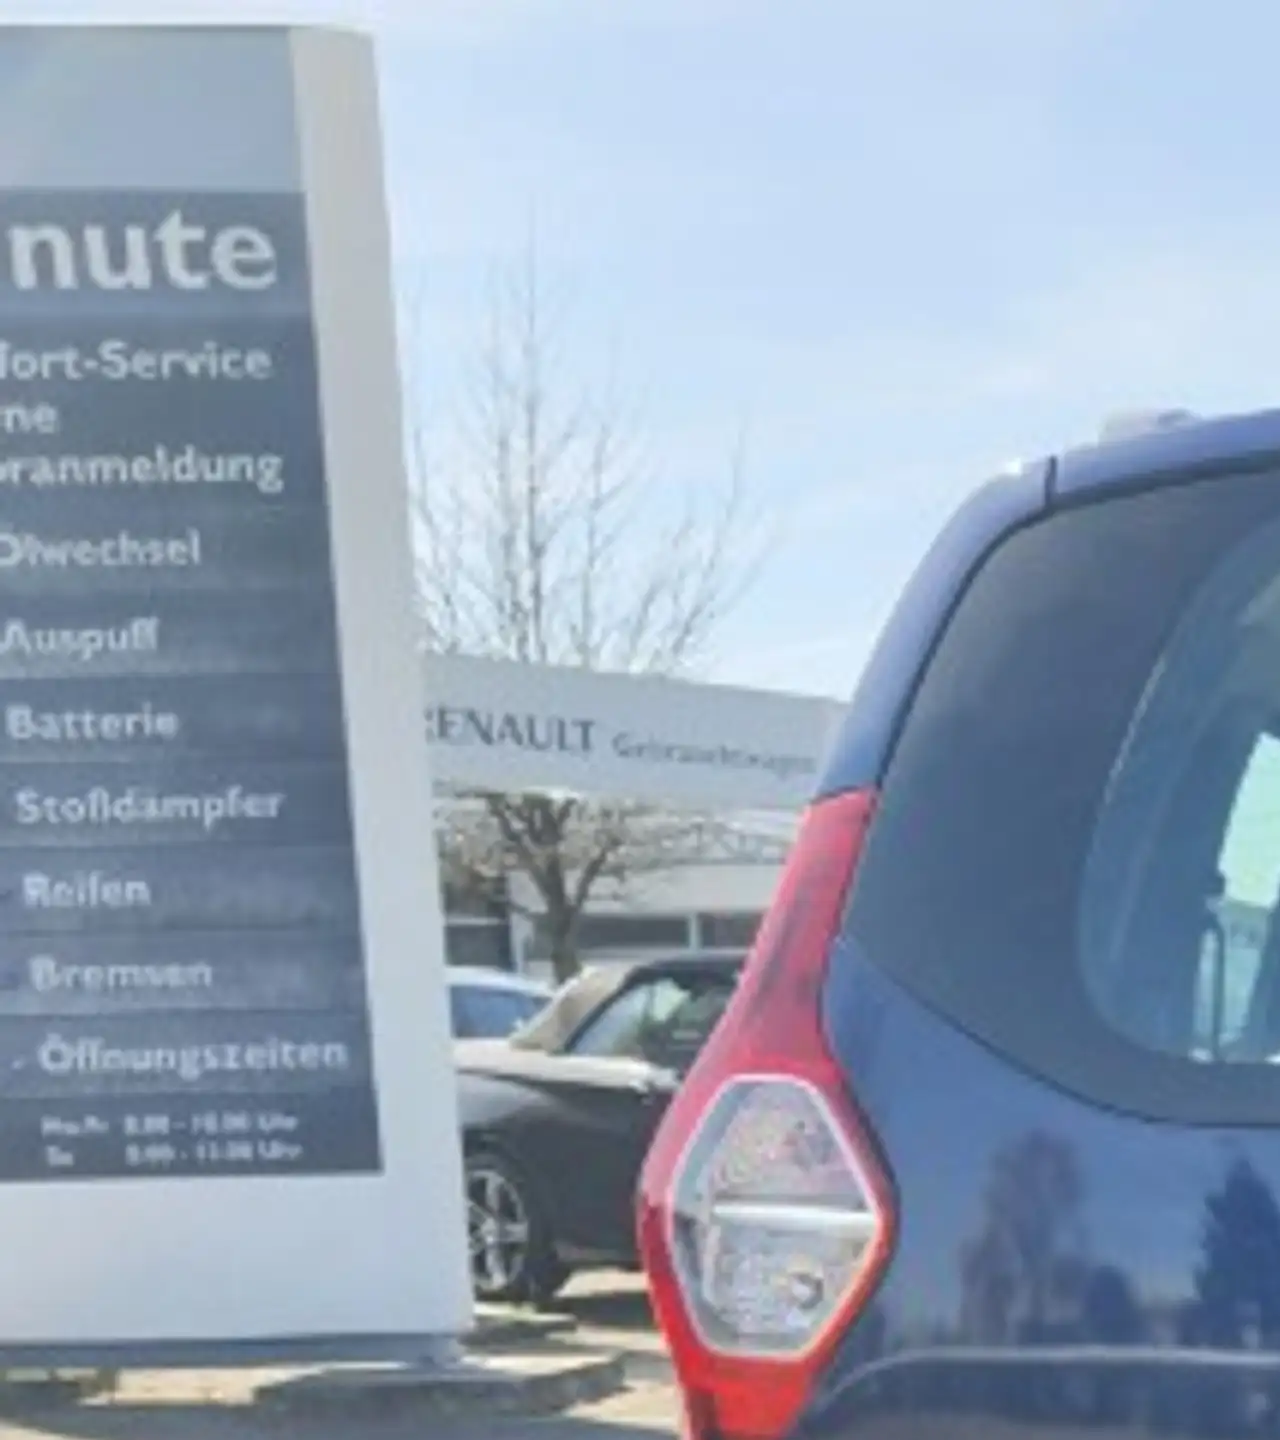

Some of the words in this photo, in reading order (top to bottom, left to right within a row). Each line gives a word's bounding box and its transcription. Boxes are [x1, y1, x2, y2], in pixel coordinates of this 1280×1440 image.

[0, 616, 160, 661] Auspuff
[5, 702, 179, 740] Batterie
[22, 869, 152, 908] Reifen
[28, 954, 214, 991] Bremsen
[38, 1034, 348, 1081] Öffnungszeiten
